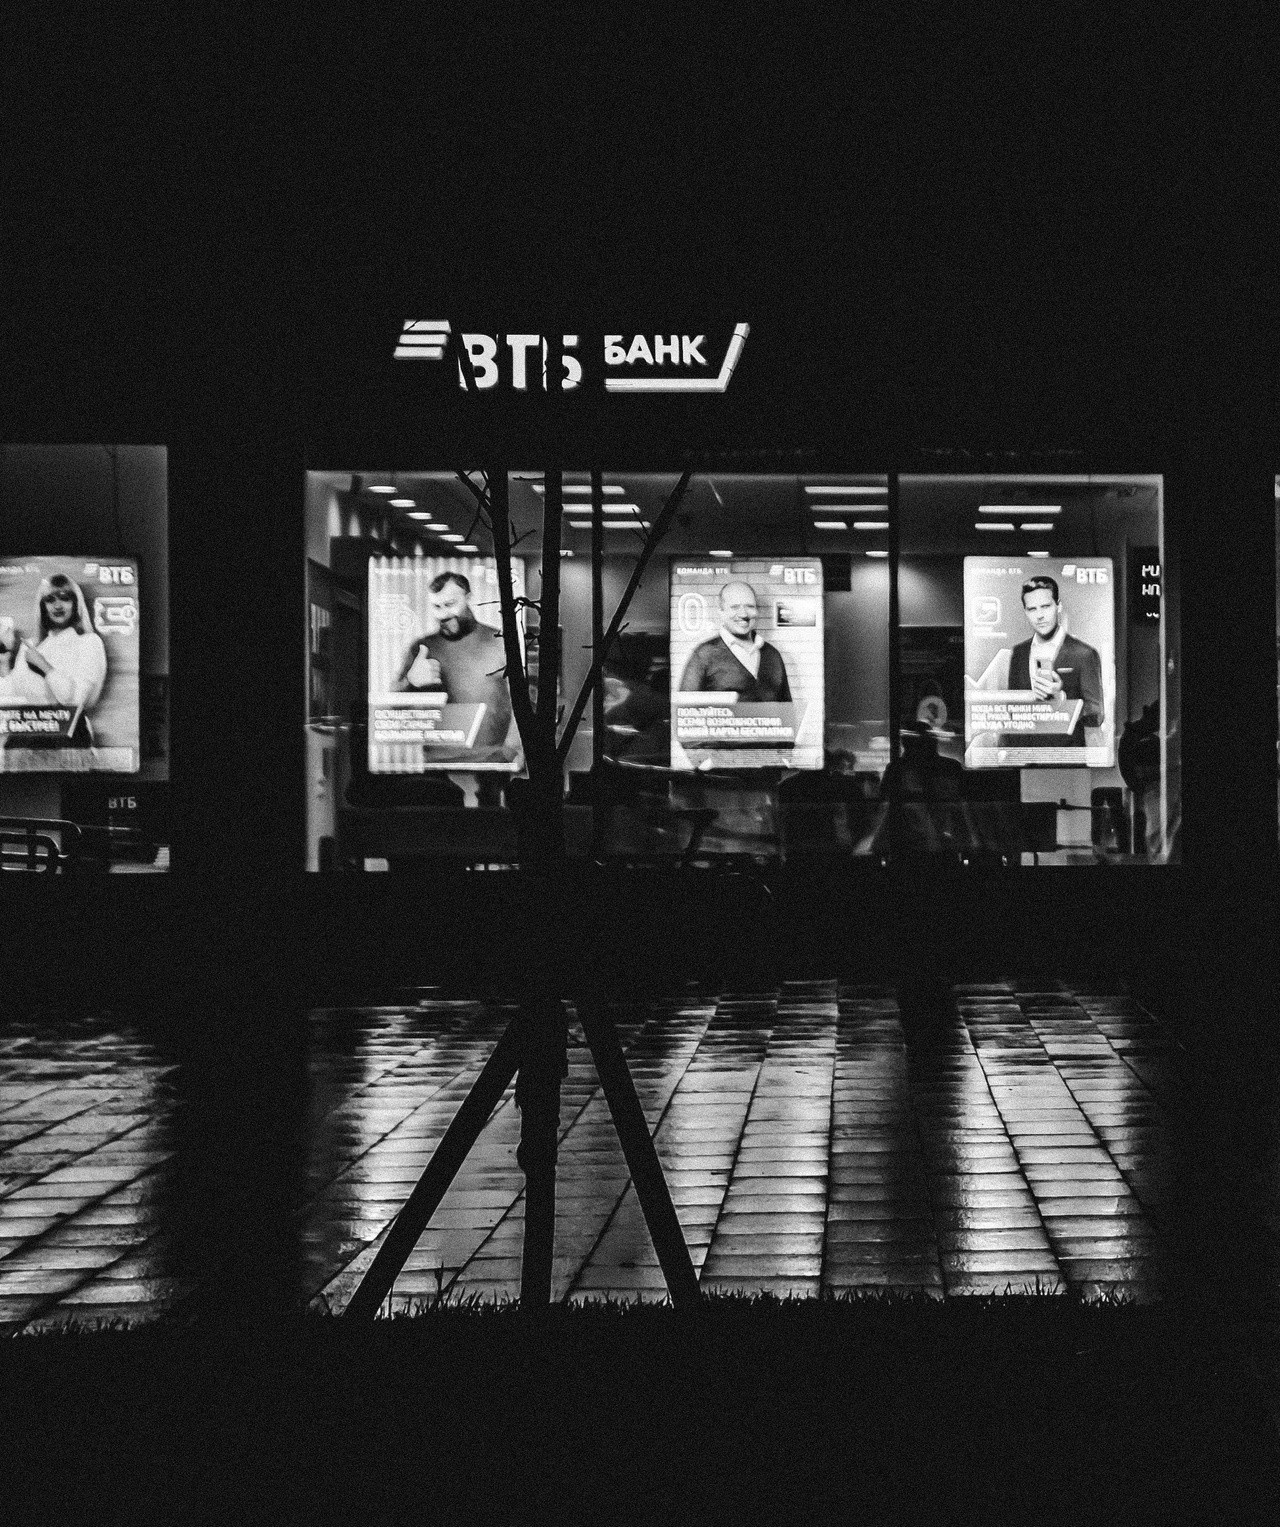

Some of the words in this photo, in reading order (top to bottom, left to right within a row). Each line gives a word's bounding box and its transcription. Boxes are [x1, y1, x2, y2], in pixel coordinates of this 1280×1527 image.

[604, 335, 708, 366] БАНК
[99, 565, 135, 586] ВТБ
[784, 567, 816, 584] ВТБ
[1076, 567, 1108, 584] ВТБ
[108, 796, 137, 809] ВТБ
